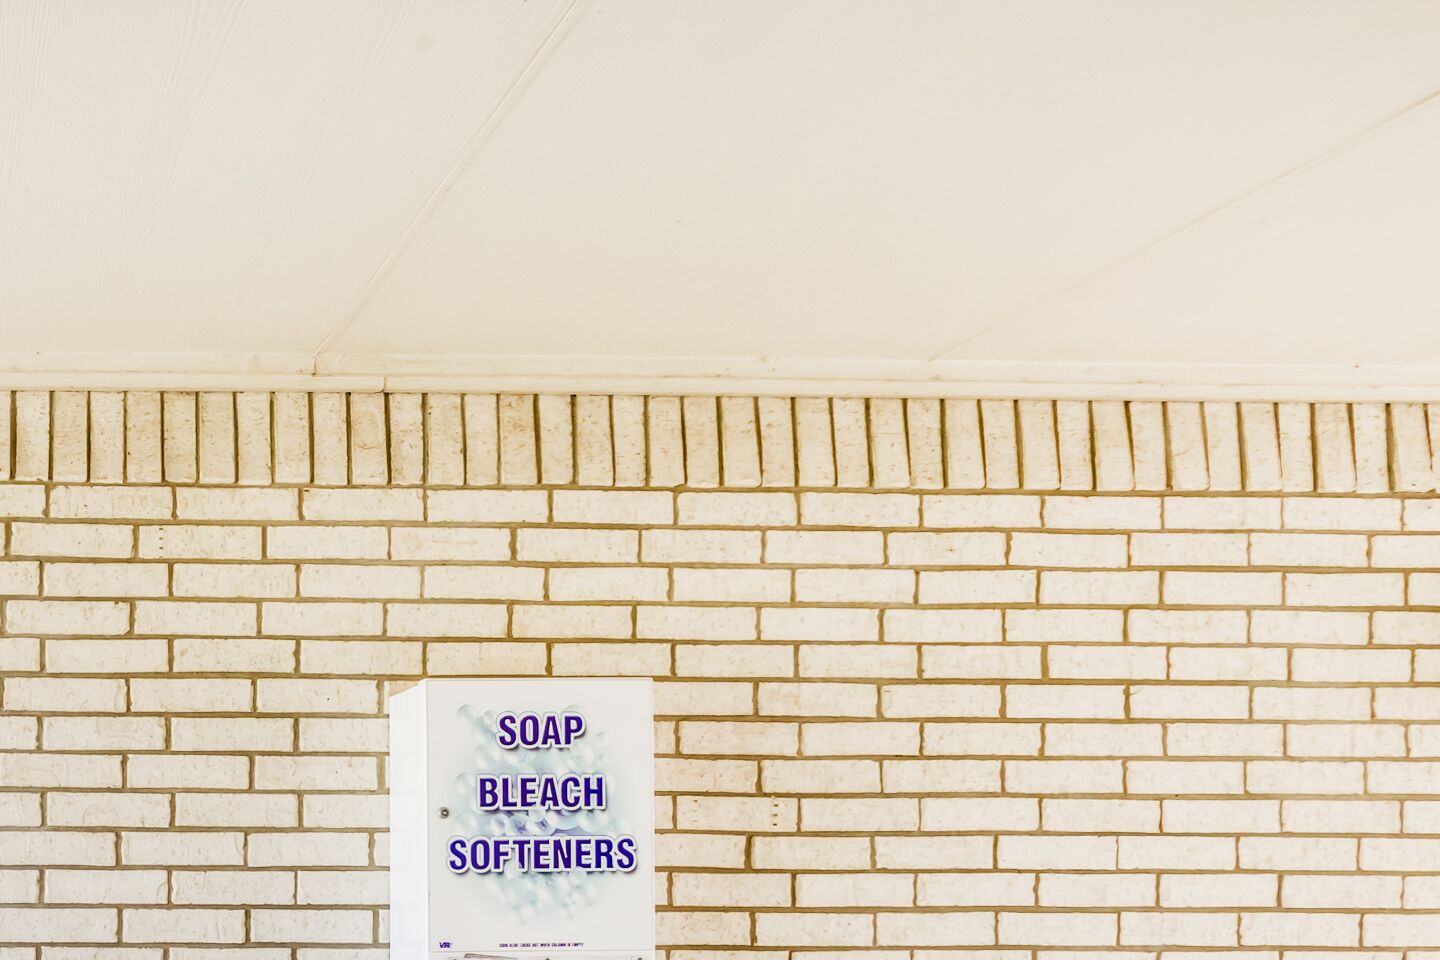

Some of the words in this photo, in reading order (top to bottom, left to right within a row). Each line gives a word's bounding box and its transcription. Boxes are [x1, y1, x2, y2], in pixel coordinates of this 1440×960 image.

[498, 714, 583, 746] SOAP
[478, 776, 604, 808] BLEACH
[448, 838, 635, 870] SOFTENERS
